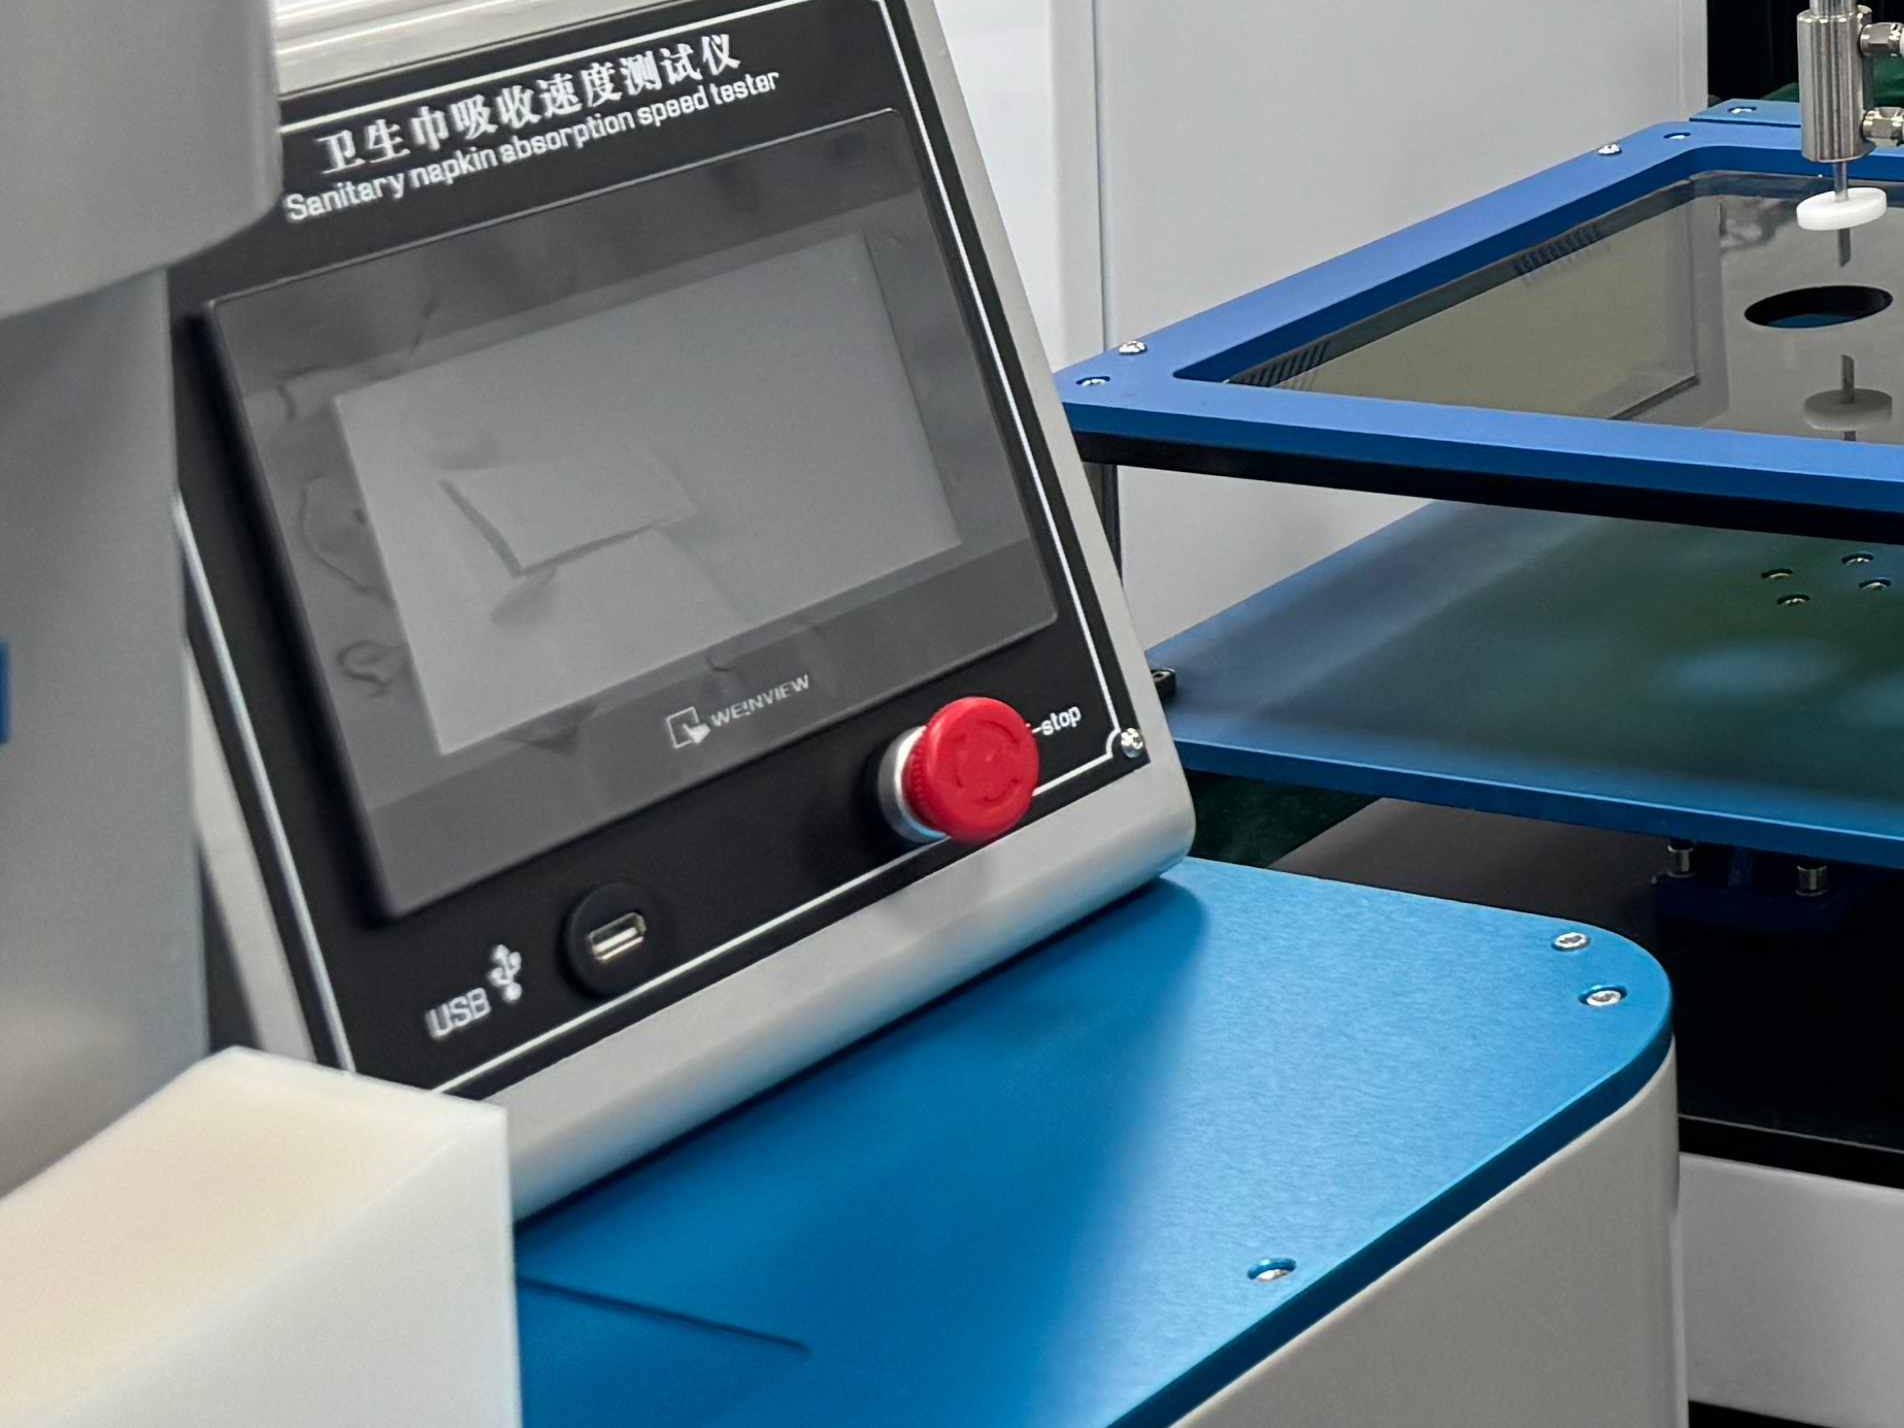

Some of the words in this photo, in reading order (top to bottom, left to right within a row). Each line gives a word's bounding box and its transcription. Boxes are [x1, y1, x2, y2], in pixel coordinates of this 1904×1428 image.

[285, 172, 405, 221] Sanitary
[407, 146, 498, 186] napkin
[500, 110, 636, 165] absorption
[637, 85, 709, 128] speed
[709, 71, 780, 105] tester
[316, 33, 742, 175] 卫生巾吸收速度测试仪
[1026, 706, 1082, 736] -stop
[424, 987, 491, 1039] USB
